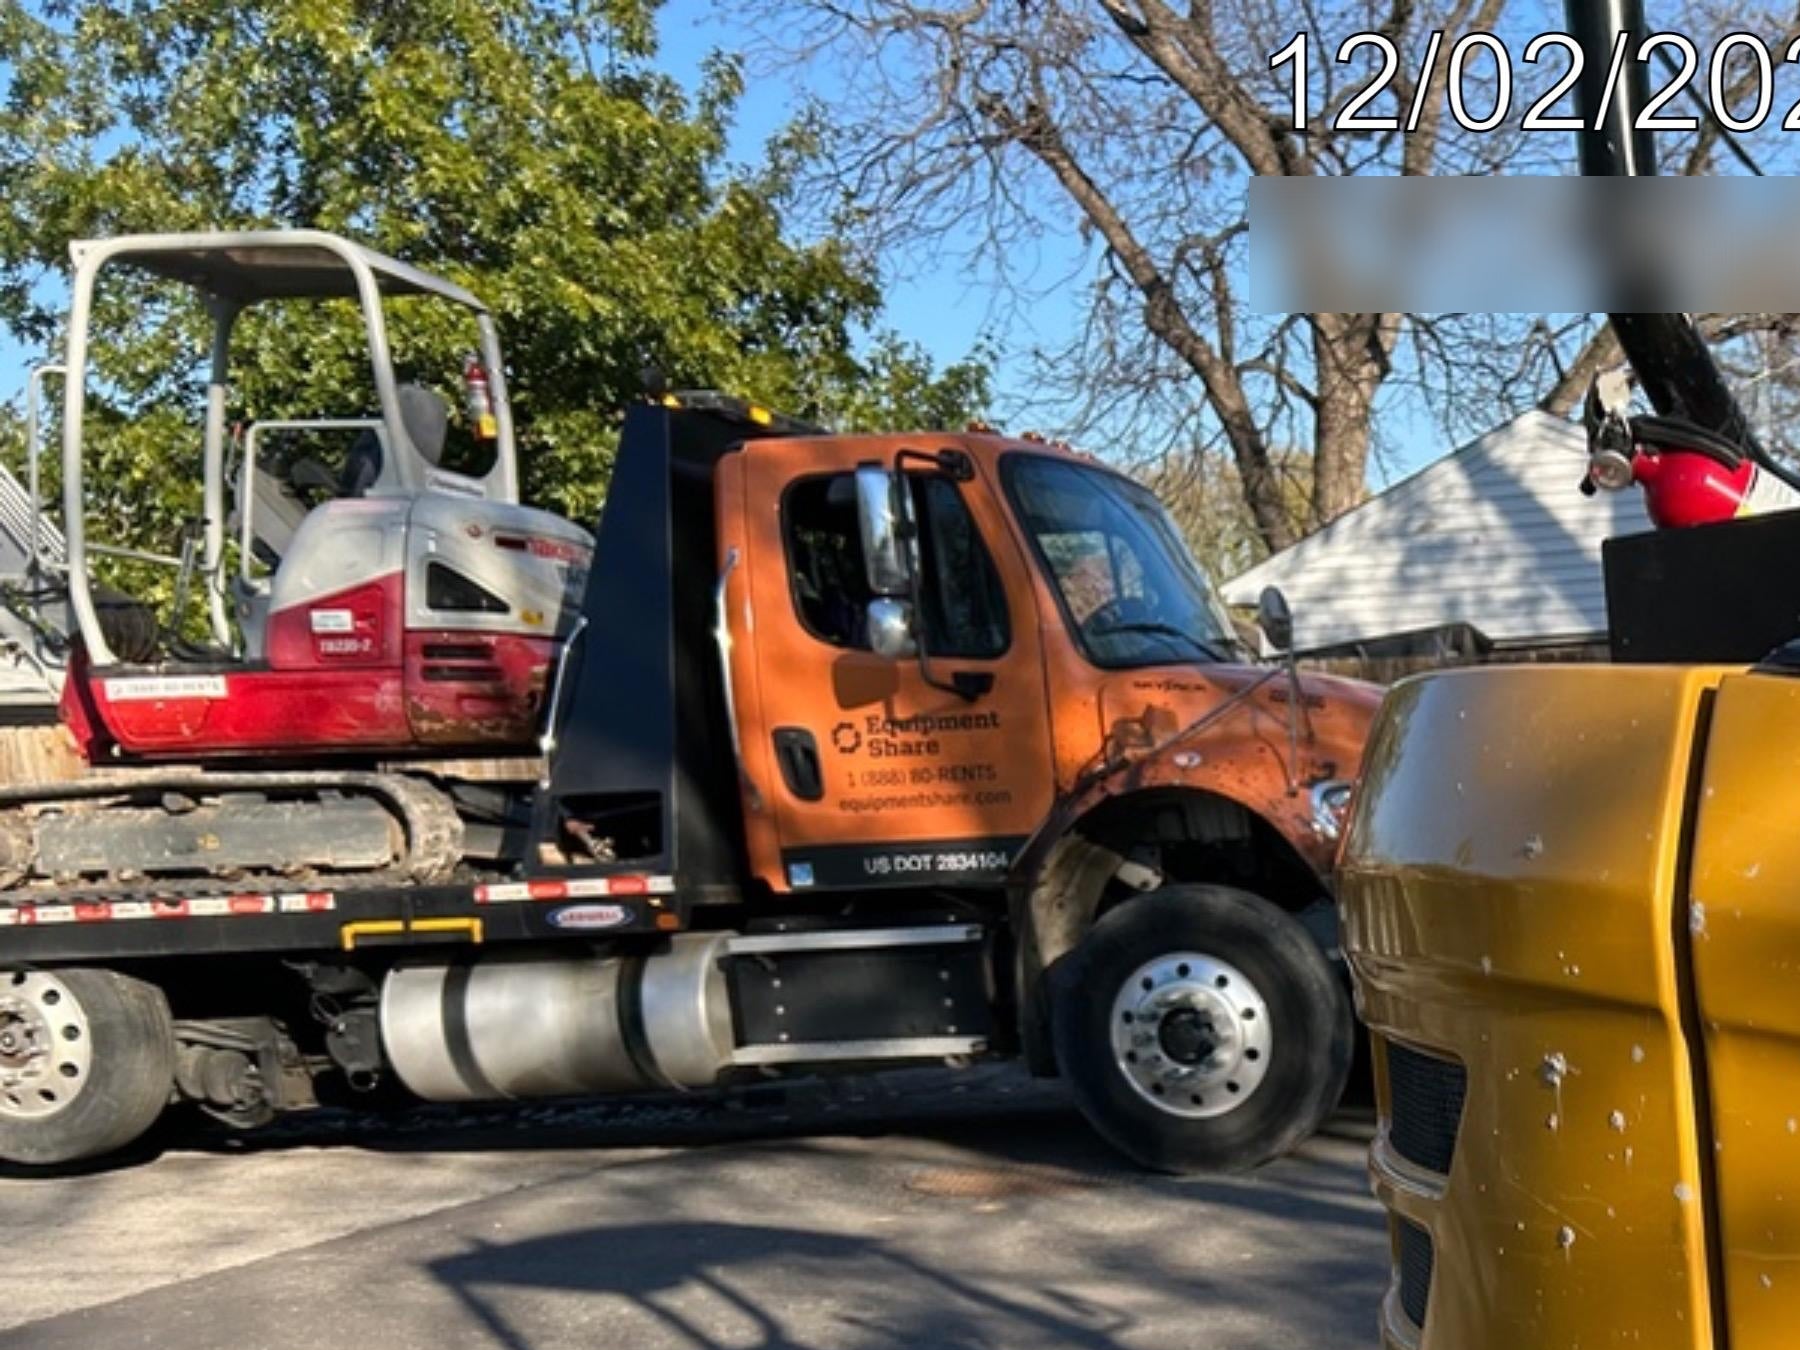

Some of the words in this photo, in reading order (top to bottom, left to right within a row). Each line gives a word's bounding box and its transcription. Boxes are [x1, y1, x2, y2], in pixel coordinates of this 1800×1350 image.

[865, 711, 1000, 737] Equipment
[867, 737, 940, 758] Share
[909, 764, 997, 784] 80-RENTS
[838, 791, 1013, 812] equipmentshare.com
[863, 856, 892, 875] US
[893, 854, 932, 872] DOT
